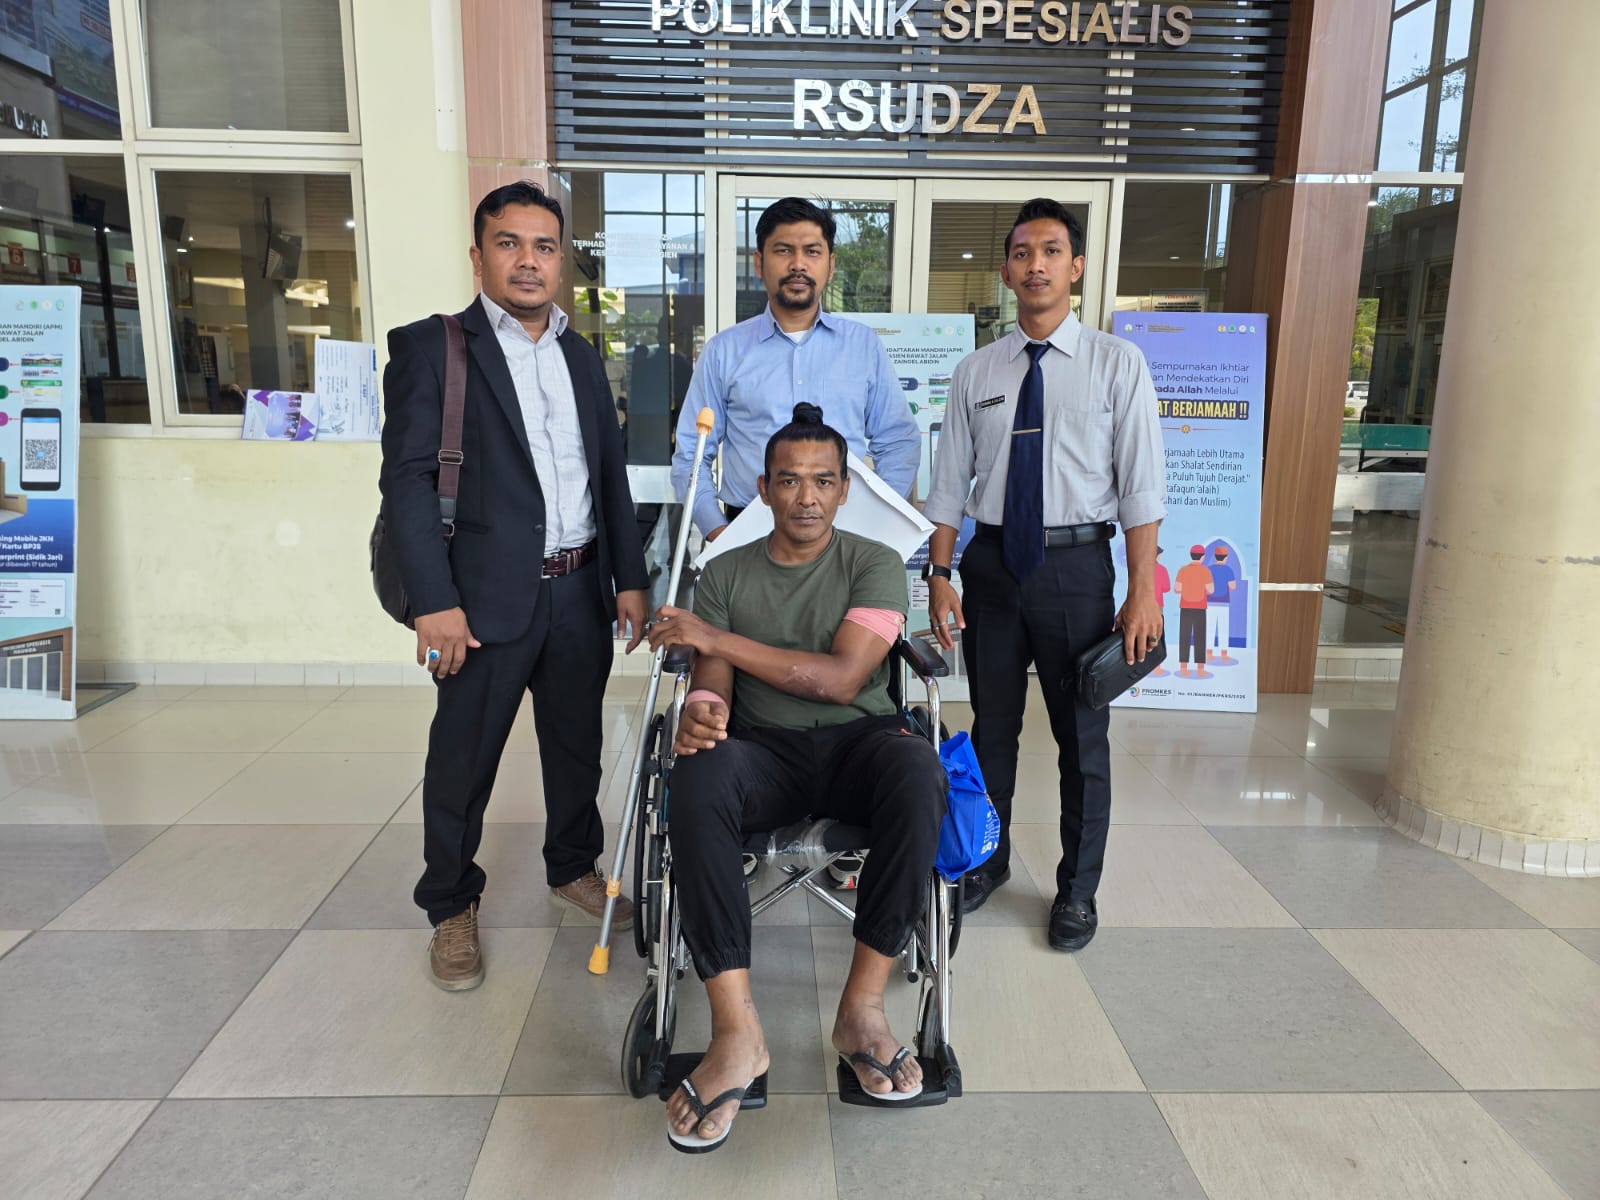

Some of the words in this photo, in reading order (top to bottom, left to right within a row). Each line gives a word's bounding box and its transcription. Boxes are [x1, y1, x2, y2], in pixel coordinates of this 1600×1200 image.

[650, 0, 919, 38] POLIKLINIK
[941, 0, 1192, 47] SPESIALIS
[794, 79, 1047, 135] RSUDZA
[1151, 361, 1218, 372] Sempurnakan
[1220, 363, 1250, 372] Ikhtiar
[1166, 373, 1231, 384] Mendekatkan
[1233, 375, 1249, 384] Diri
[1177, 385, 1203, 394] Allah
[1204, 386, 1239, 395] Melalui
[1172, 400, 1237, 418] BERJAMAAH
[1239, 402, 1248, 419] !!
[1197, 448, 1218, 458] Lebih
[1219, 449, 1245, 459] Utama
[1180, 460, 1205, 470] Shalat
[1206, 461, 1242, 471] Sendirian
[1172, 471, 1194, 481] Puluh
[1196, 472, 1216, 483] Tujuh
[1184, 496, 1199, 506] dan
[1200, 497, 1231, 508] Muslim)
[1141, 687, 1172, 695] PROMKES
